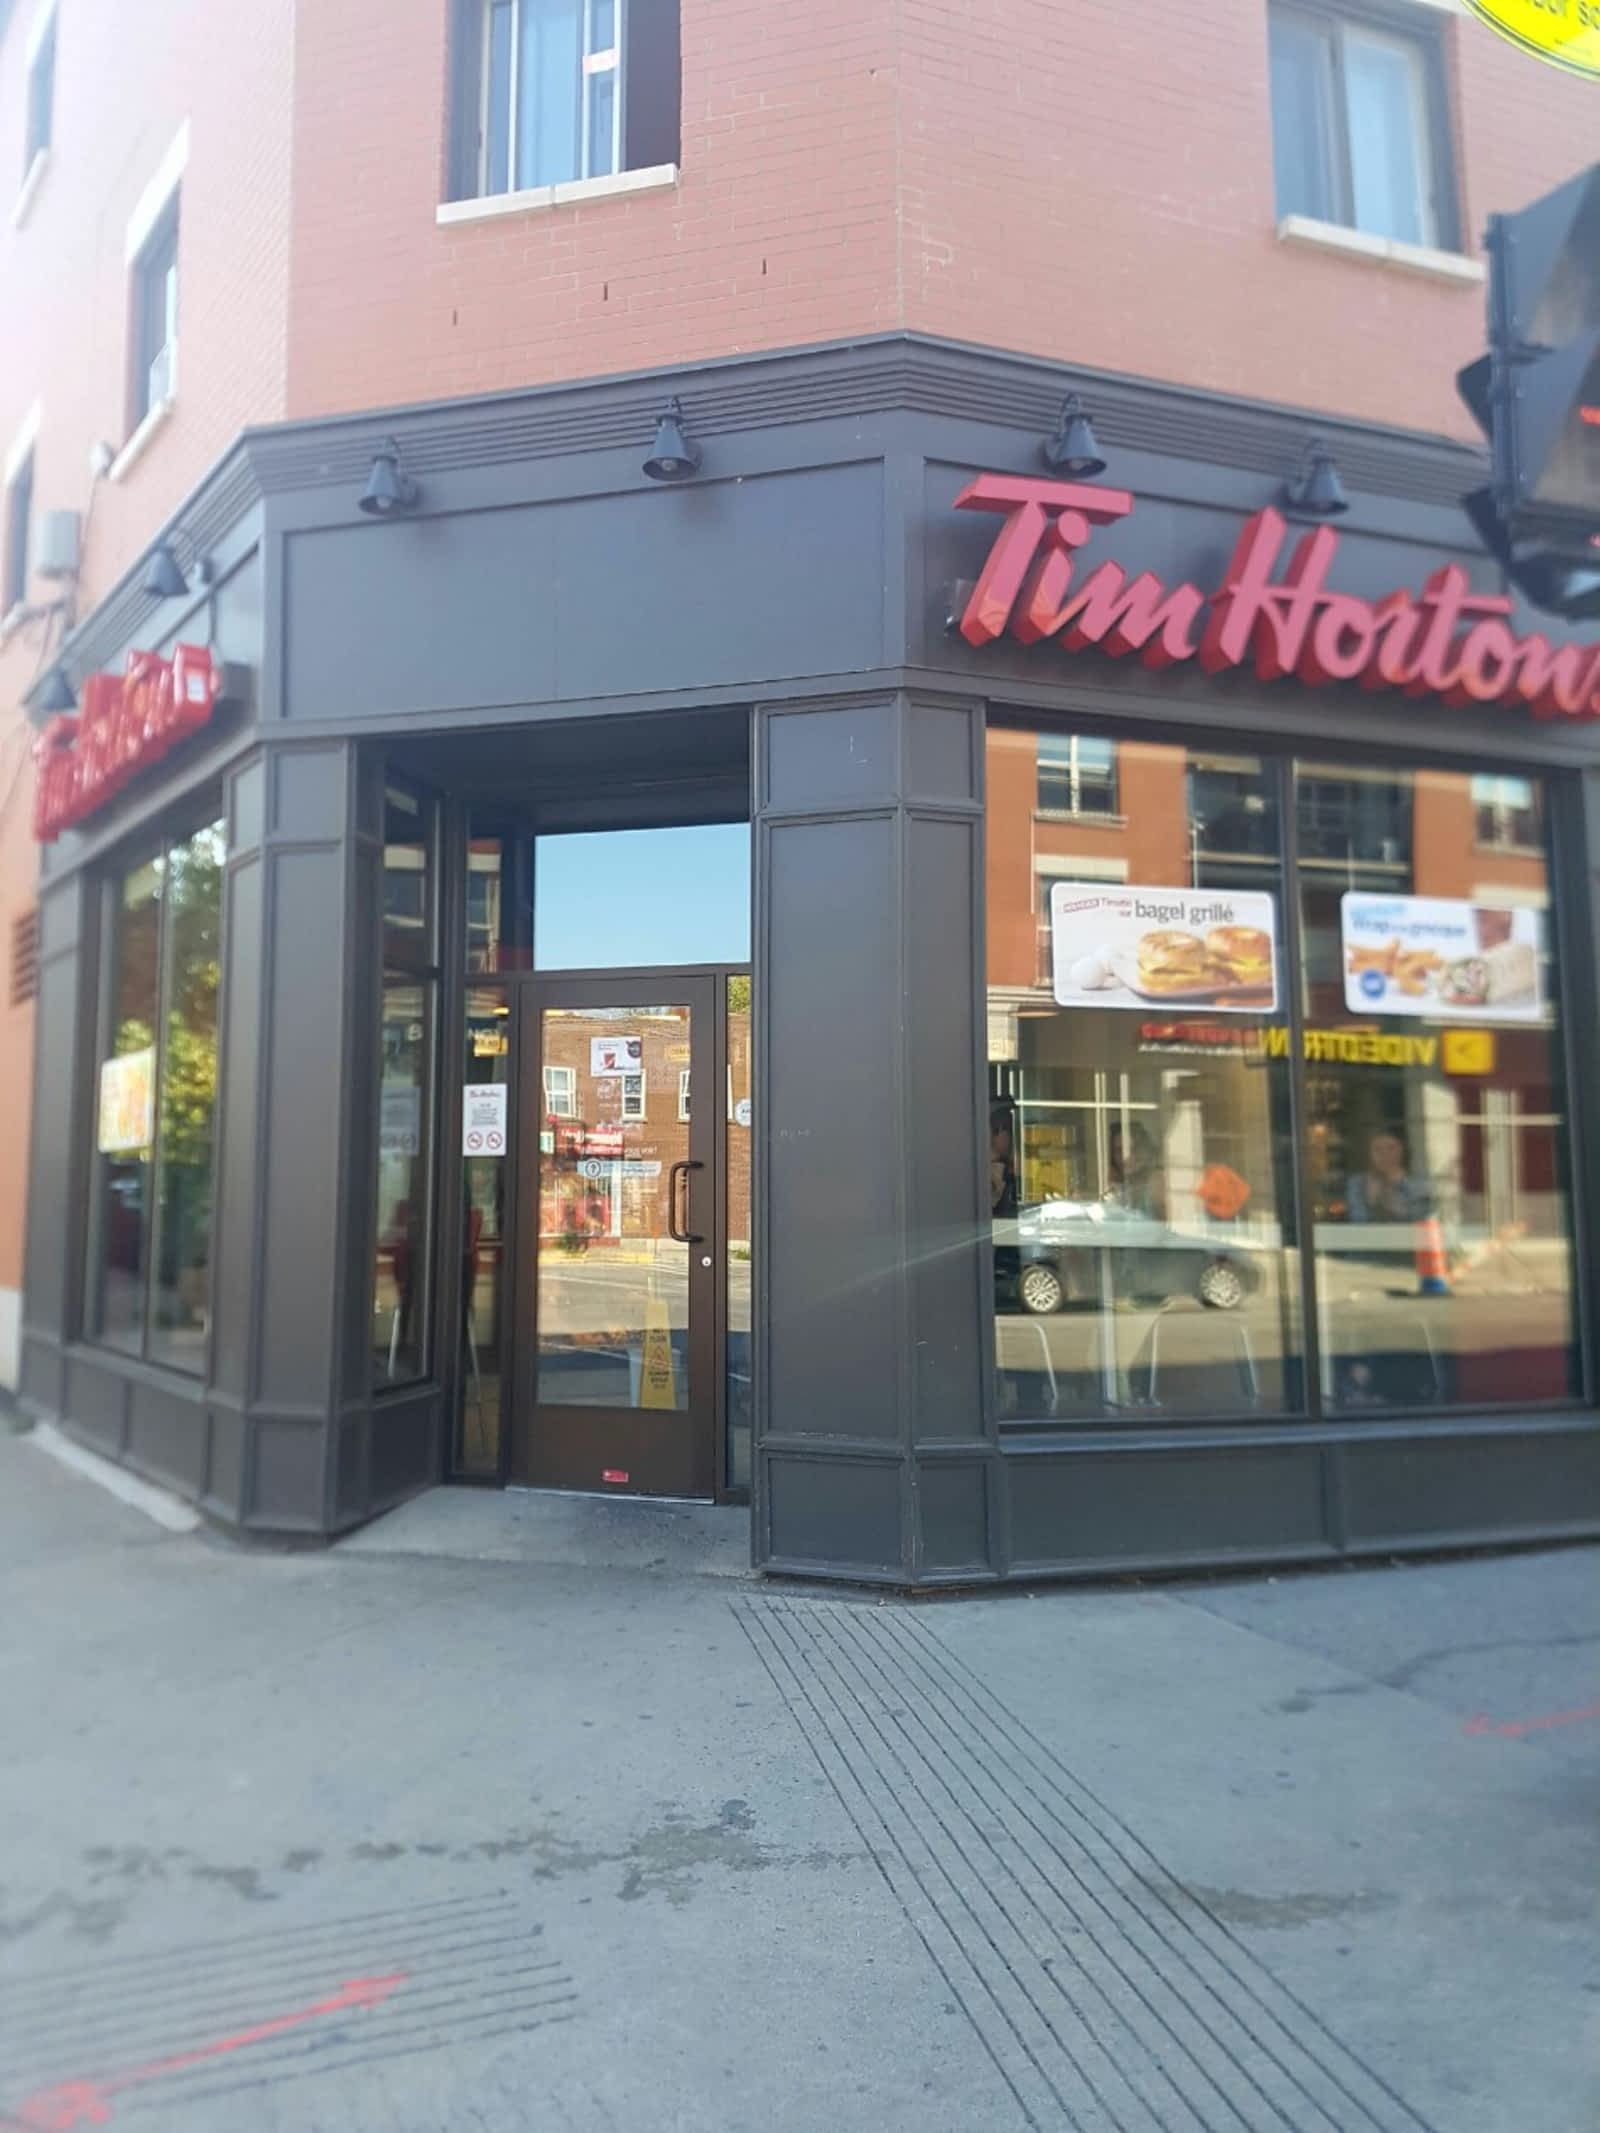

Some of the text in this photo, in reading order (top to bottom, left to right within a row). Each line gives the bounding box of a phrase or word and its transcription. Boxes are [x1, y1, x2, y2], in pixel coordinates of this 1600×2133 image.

[953, 473, 1203, 669] Tim
[1135, 900, 1185, 923] bagel
[1189, 901, 1235, 925] grillé
